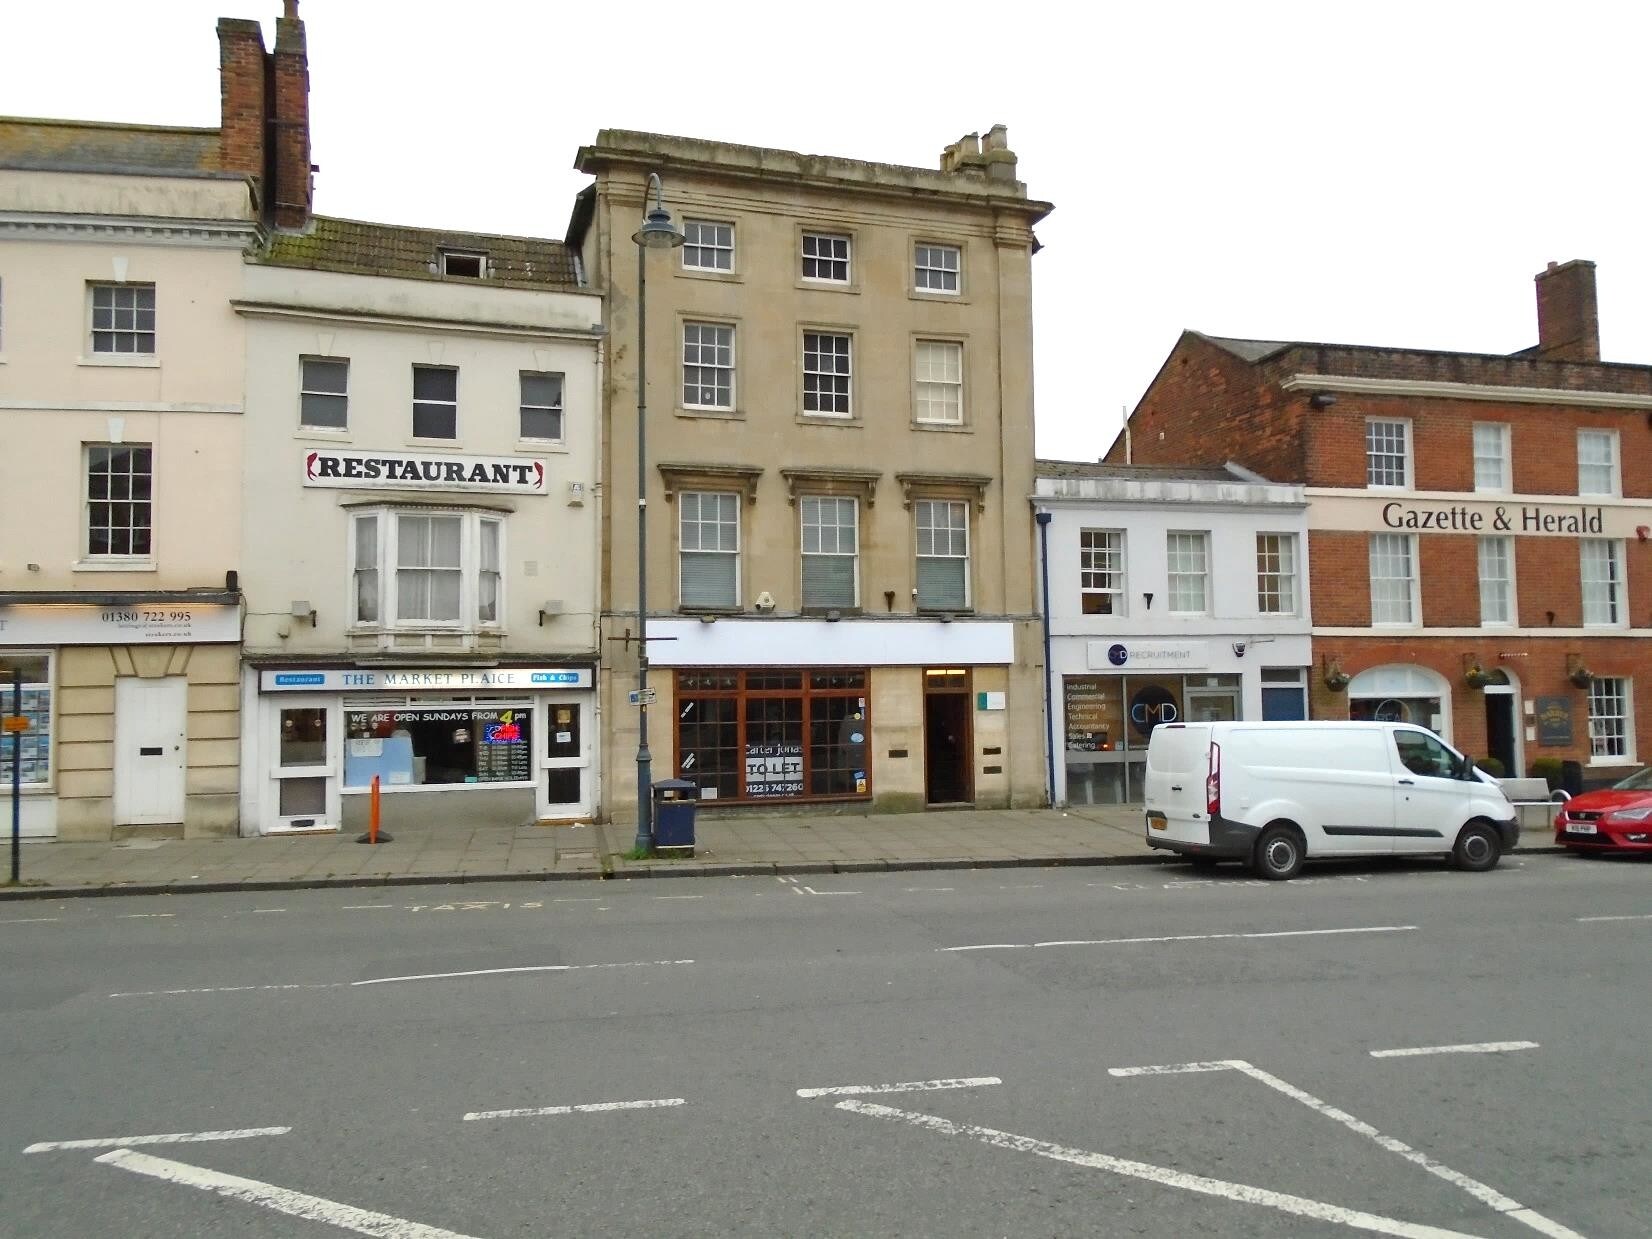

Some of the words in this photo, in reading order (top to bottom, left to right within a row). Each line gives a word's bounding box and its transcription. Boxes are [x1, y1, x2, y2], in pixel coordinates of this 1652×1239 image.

[318, 456, 533, 484] RESTAURANT
[1382, 502, 1483, 530] Gazette
[1493, 506, 1511, 531] &
[1522, 507, 1603, 533] Herald
[102, 611, 138, 622] 01380
[143, 611, 165, 622] 722
[170, 611, 191, 622] 995
[344, 674, 375, 685] THE
[384, 673, 452, 685] MARKET
[462, 673, 516, 684] PLAICE
[1067, 693, 1105, 701] Commercial
[1067, 703, 1106, 711] Engineering
[1131, 703, 1177, 722] CMD
[351, 713, 367, 723] WE
[371, 713, 390, 723] ARE
[393, 713, 419, 722] OPEN
[422, 712, 469, 722] SUNDAYS
[472, 711, 498, 721] FROM
[499, 710, 513, 724] 4
[514, 712, 527, 722] pm
[747, 763, 768, 775] TO
[773, 762, 800, 775] LET
[403, 902, 541, 912] TAXIS
